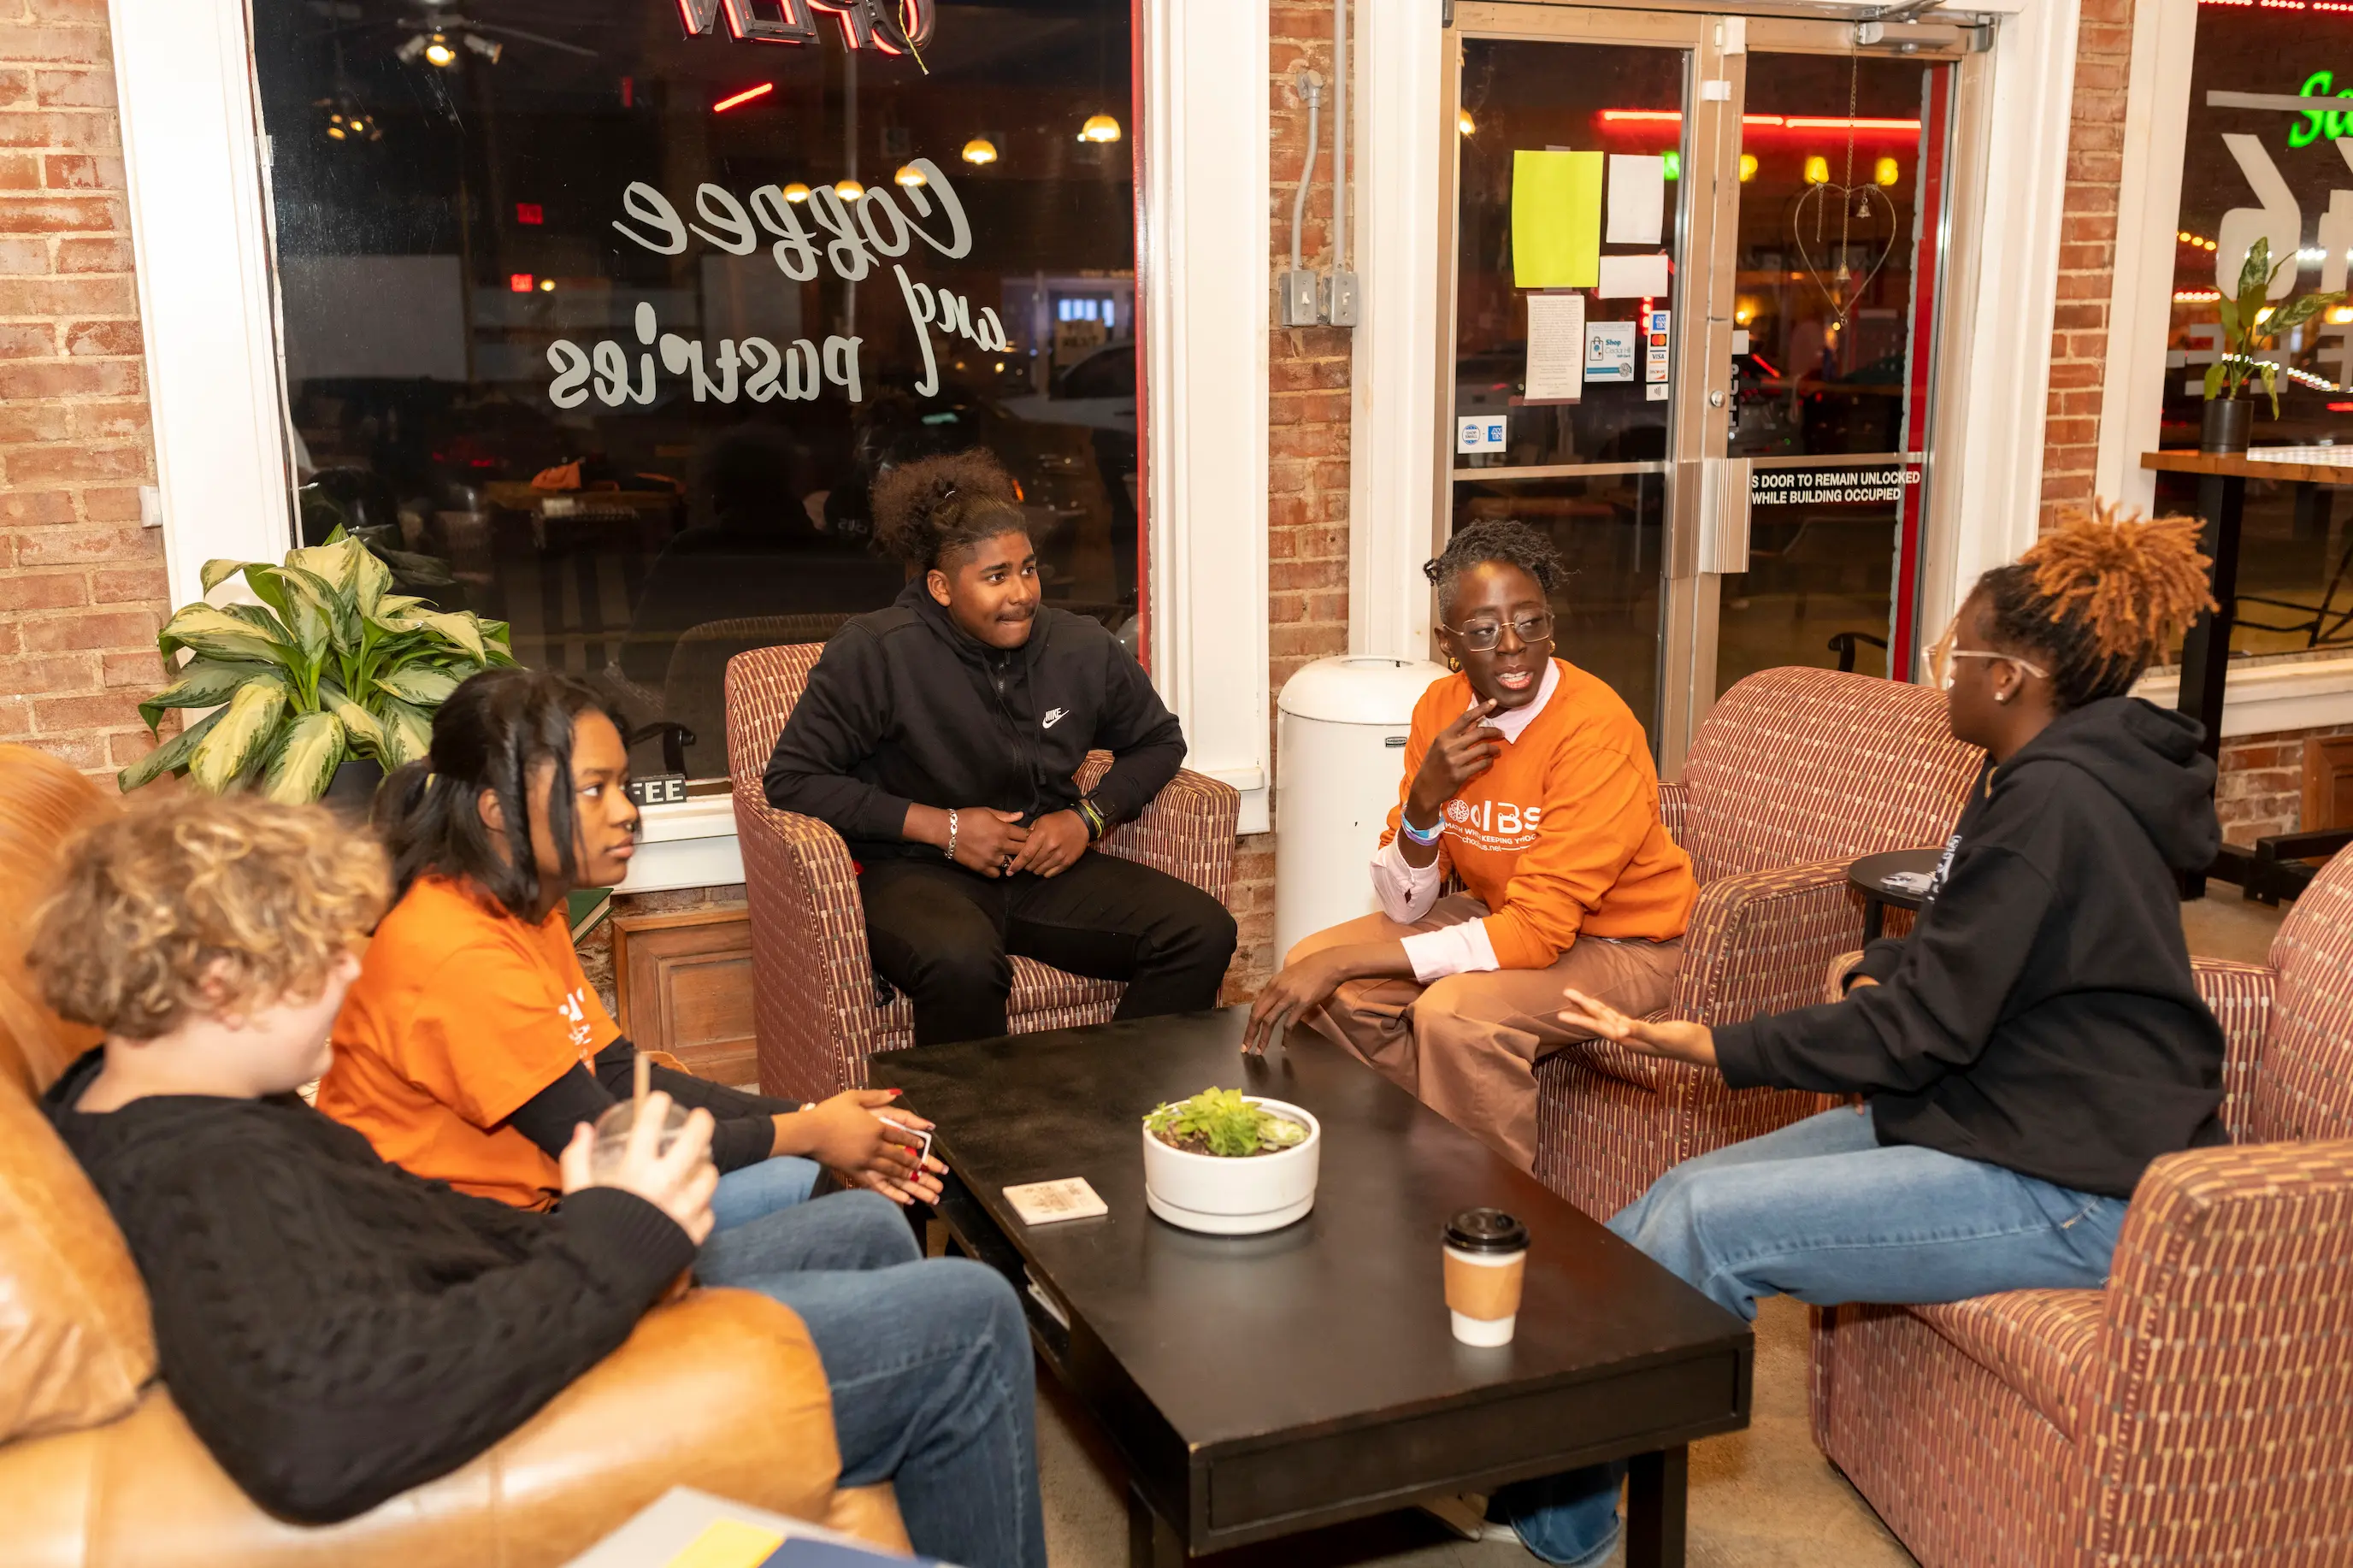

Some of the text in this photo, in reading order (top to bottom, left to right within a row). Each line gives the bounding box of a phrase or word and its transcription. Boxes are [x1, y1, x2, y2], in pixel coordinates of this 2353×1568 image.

[1606, 339, 1621, 347] Shop
[1761, 474, 1795, 488] DOOR
[1797, 474, 1813, 487] TO
[1815, 472, 1858, 486] REMAIN
[1861, 470, 1920, 486] UNLOCKED
[1752, 487, 1901, 505] WHILE BUILDING OCCUPIED
[1045, 707, 1062, 722] NIKE
[1445, 822, 1463, 833] MATH
[1481, 834, 1513, 845] KEEPING
